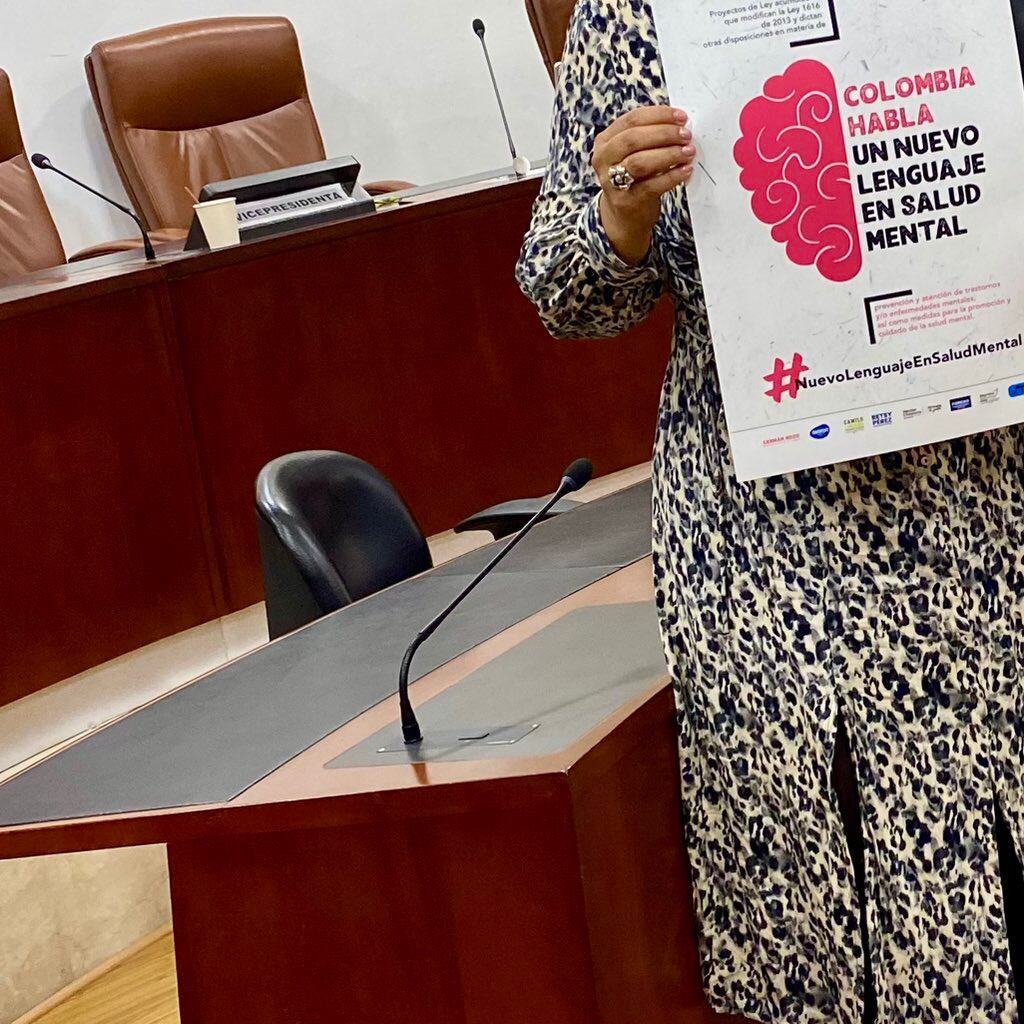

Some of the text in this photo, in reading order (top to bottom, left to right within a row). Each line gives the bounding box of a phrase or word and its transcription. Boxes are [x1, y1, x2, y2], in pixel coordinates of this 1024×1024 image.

[709, 7, 746, 17] Proyectos
[724, 18, 738, 26] que
[740, 11, 777, 21] modifican
[802, 2, 821, 11] 1616
[761, 13, 822, 29] de 2013 y dictan
[703, 39, 722, 48] otras
[723, 31, 773, 44] disposiciones
[786, 24, 814, 33] materia
[816, 21, 826, 29] de
[843, 66, 976, 107] COLOMBIA
[847, 103, 934, 137] HABLA
[852, 125, 979, 165] UN NUEVO
[857, 152, 986, 195] LENGUAJE
[861, 184, 981, 223] EN SALUD
[866, 215, 968, 252] MENTAL
[762, 333, 1023, 404] #NuevoLenguajeEnSaludMental
